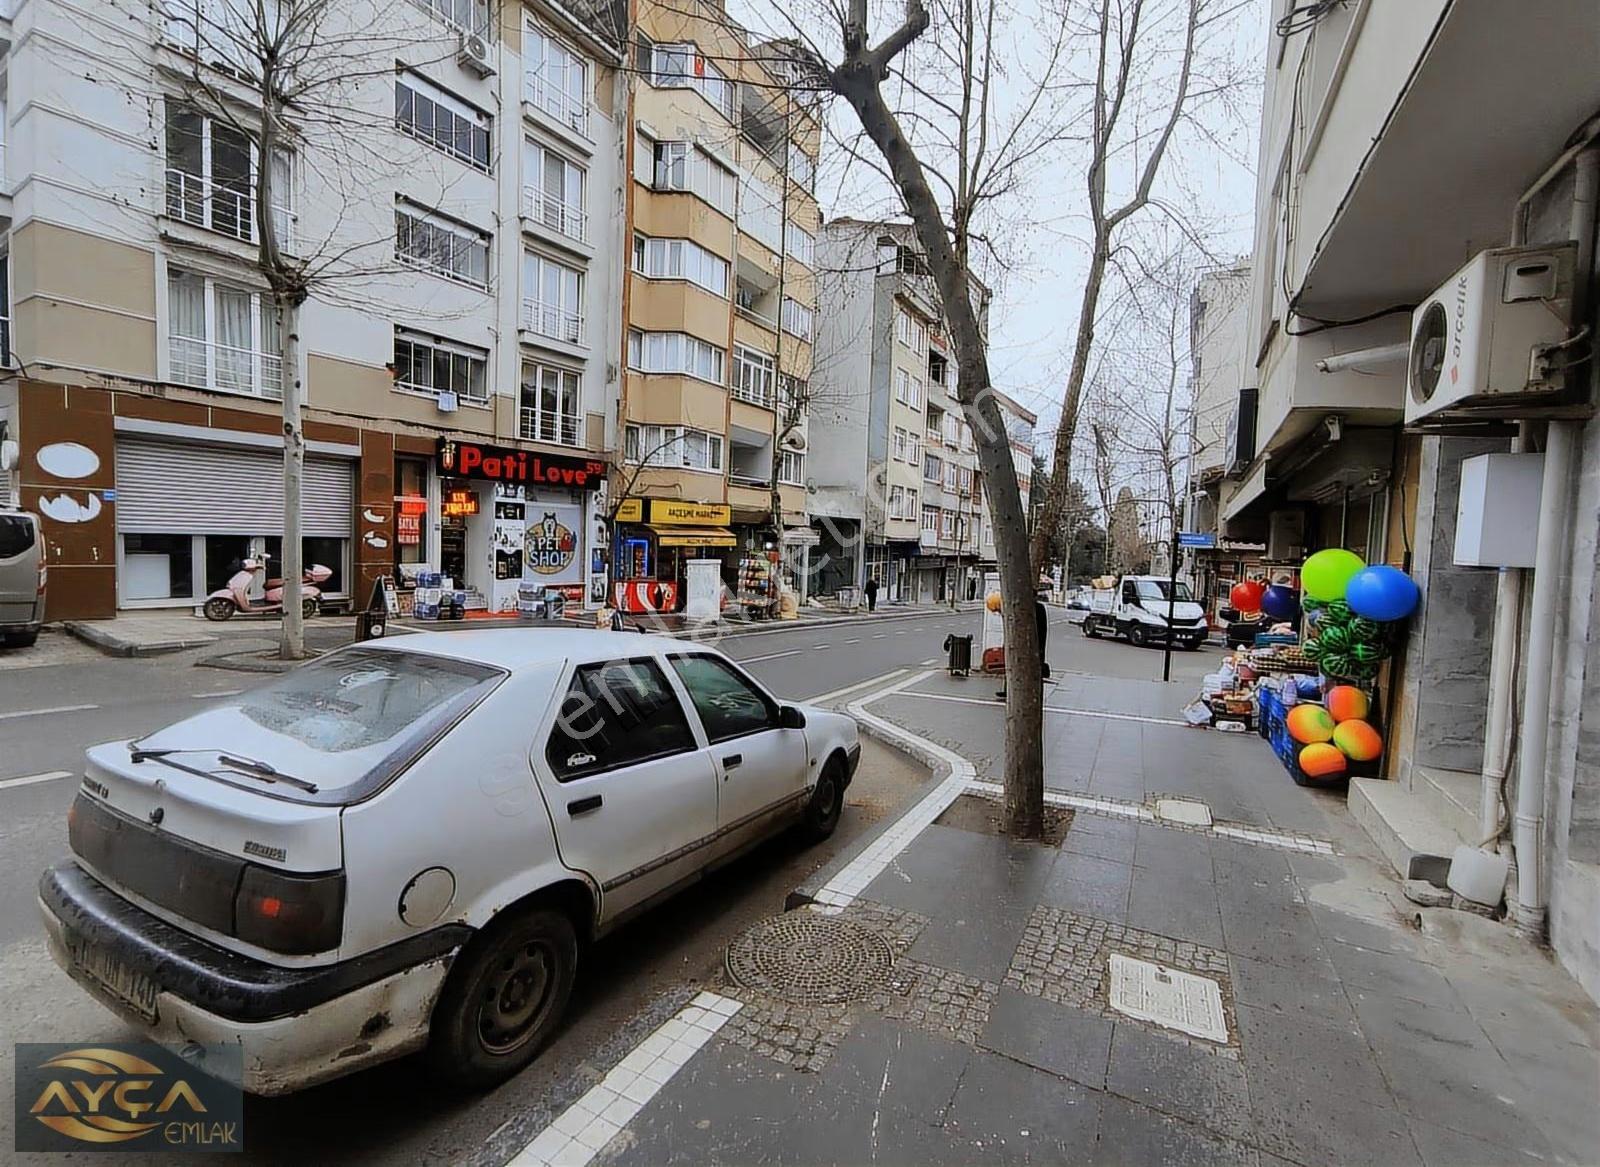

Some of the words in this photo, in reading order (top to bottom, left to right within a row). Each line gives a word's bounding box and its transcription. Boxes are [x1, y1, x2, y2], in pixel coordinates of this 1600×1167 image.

[1453, 275, 1468, 358] arçelik
[460, 445, 526, 479] Pati
[534, 459, 587, 485] Love
[538, 537, 561, 550] PET
[530, 551, 569, 566] SHOP
